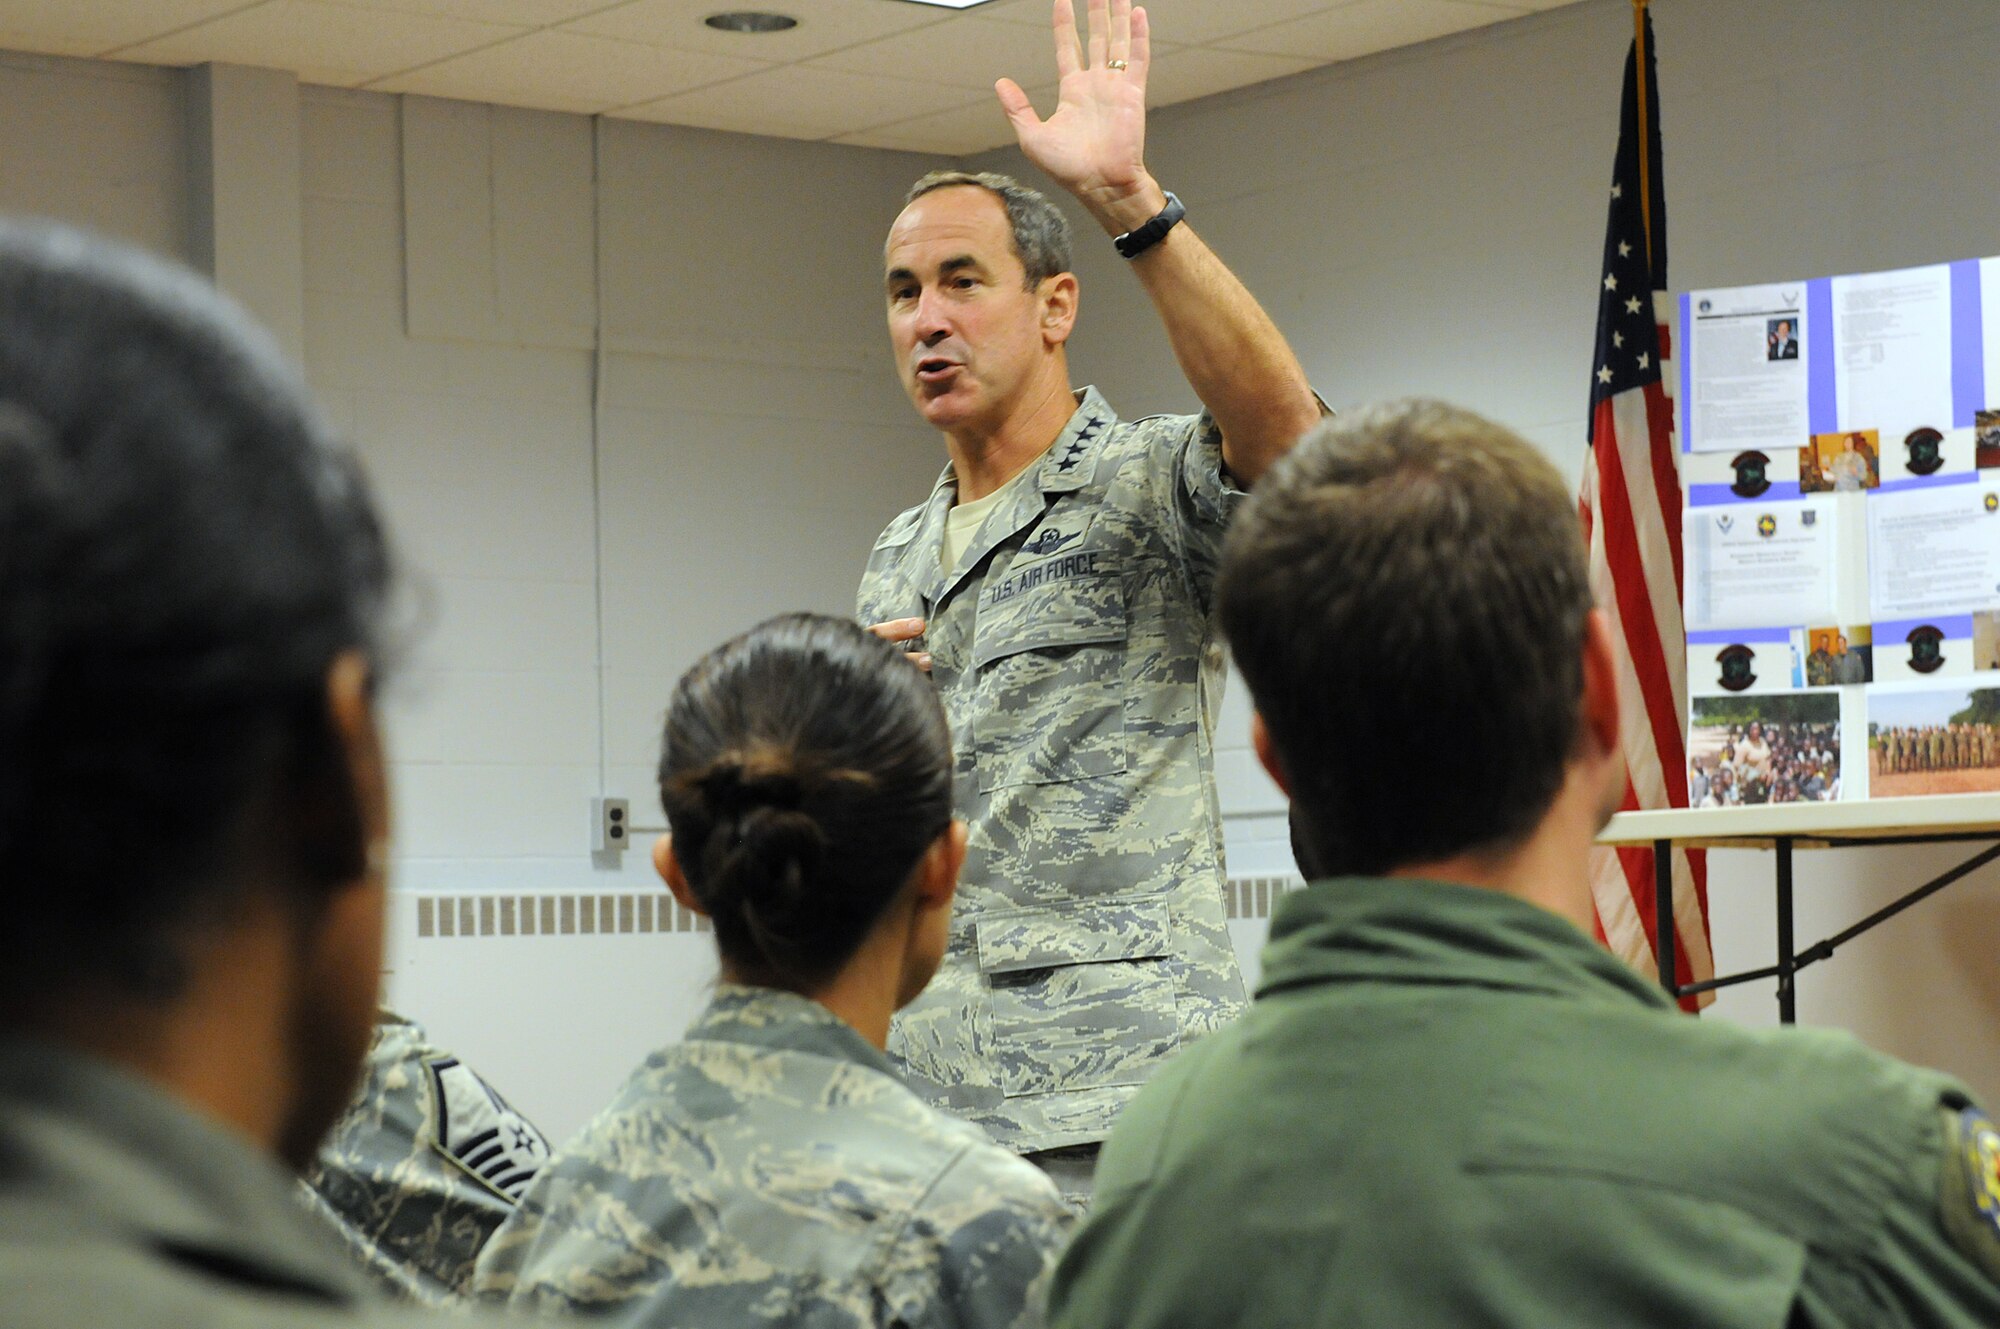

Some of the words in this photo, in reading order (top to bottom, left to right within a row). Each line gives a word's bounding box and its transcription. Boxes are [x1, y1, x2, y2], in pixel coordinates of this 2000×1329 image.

[992, 580, 1015, 603] U.S.
[1019, 568, 1042, 592] AIR
[1046, 553, 1099, 580] FORCE
